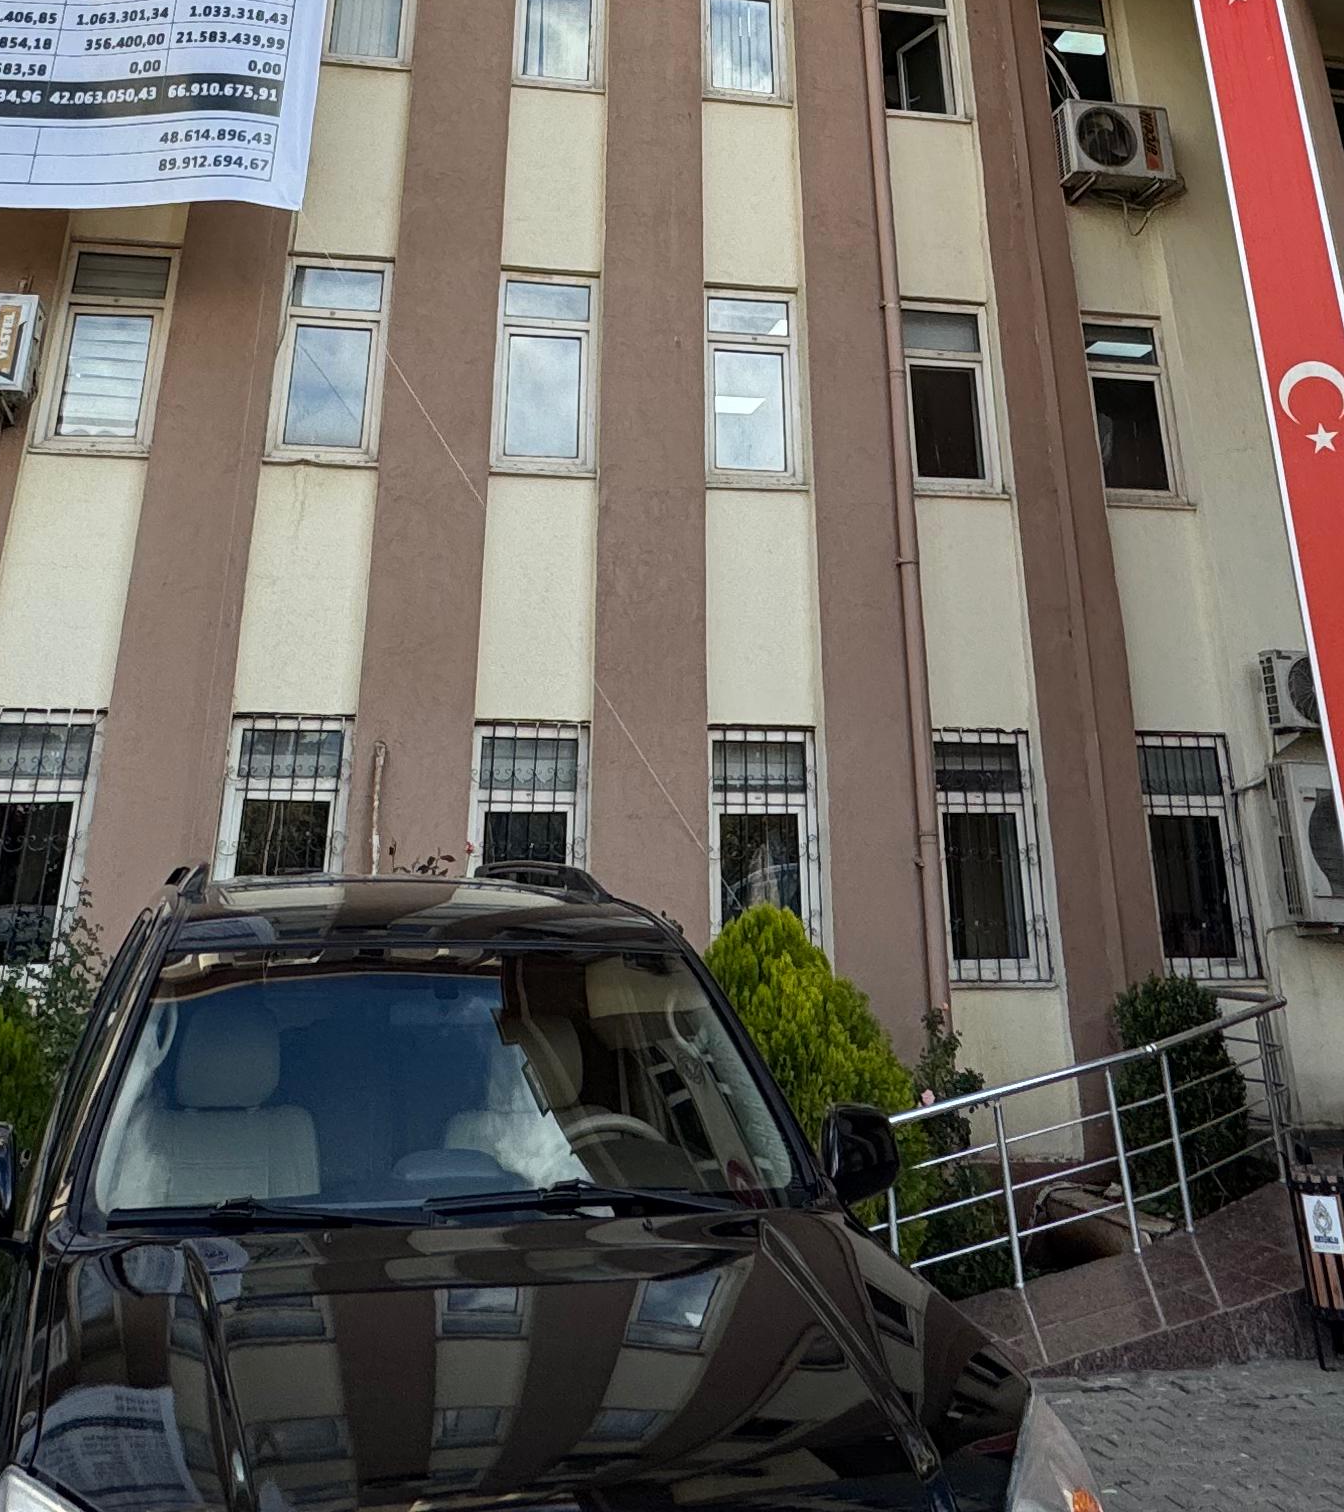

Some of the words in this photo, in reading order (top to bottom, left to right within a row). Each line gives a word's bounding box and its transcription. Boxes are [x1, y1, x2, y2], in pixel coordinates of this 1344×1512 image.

[77, 7, 169, 26] 1.063.301,34
[189, 5, 288, 26] 1.033.318,43
[85, 33, 164, 52] 356.400,00
[176, 32, 285, 50] 21.583.439,99
[129, 60, 161, 74] 0,00
[248, 60, 281, 75] 0,00
[50, 86, 157, 105] 42.063.050,43
[168, 82, 278, 102] 66.910.675,91
[159, 128, 272, 146] 48.614.896,43
[158, 155, 269, 172] 89.912.694,67
